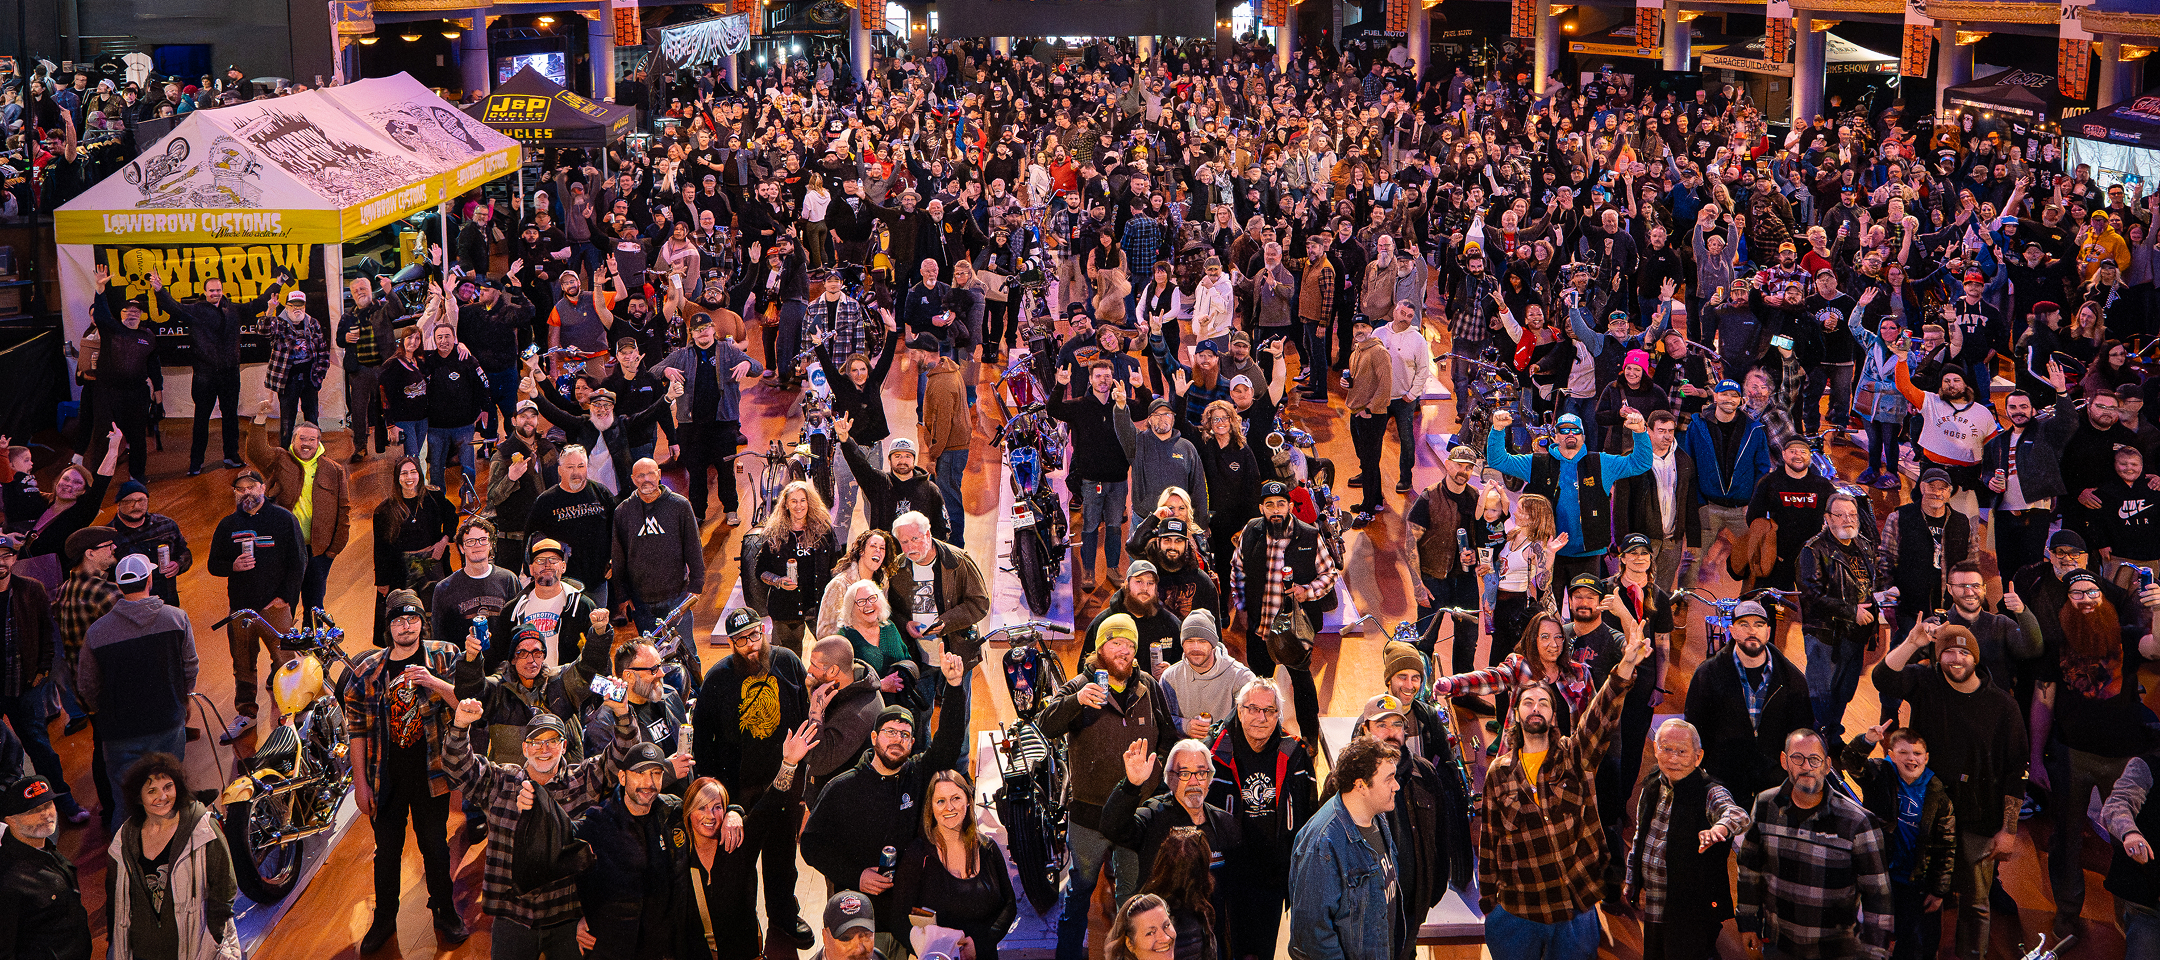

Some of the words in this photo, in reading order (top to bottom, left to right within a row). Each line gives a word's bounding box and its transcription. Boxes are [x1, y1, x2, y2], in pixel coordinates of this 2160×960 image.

[1714, 57, 1779, 72] GARAGEBUILD.COM
[1844, 63, 1870, 73] SHOW
[491, 98, 546, 112] J&P
[2062, 107, 2090, 119] MOT
[498, 128, 553, 139] YCLES
[360, 193, 397, 225] LOWBROW
[398, 183, 427, 210] CUSTOMS
[103, 213, 197, 235] LOWBROW
[202, 212, 282, 233] CUSTOMS
[211, 227, 240, 239] Where
[106, 243, 312, 291] LOWBROW
[1943, 429, 1967, 440] HOGS
[553, 503, 588, 516] HARLEY
[2122, 499, 2145, 511] NIKE
[558, 504, 605, 519] DAVIDSON
[2125, 518, 2149, 526] AIR
[530, 611, 556, 620] THROTTLE
